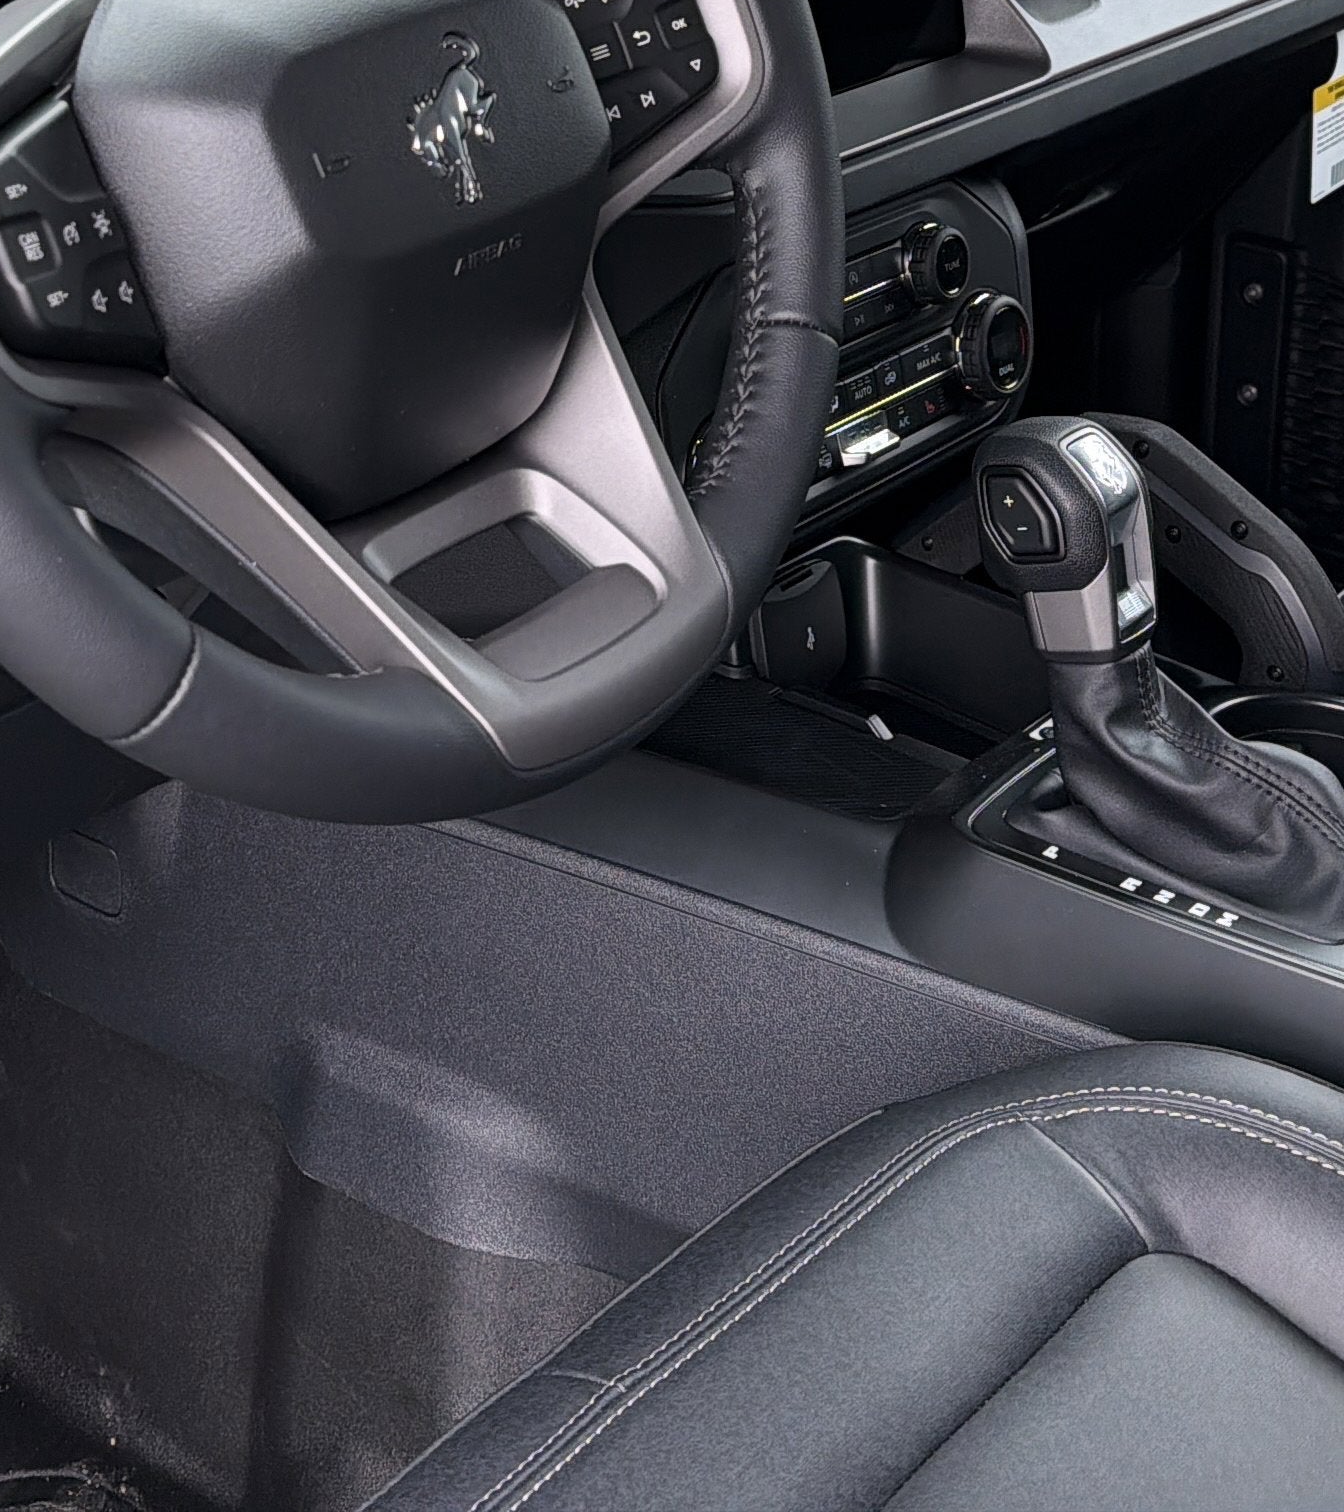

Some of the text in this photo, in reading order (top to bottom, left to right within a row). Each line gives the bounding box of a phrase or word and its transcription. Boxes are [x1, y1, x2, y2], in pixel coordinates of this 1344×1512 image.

[671, 17, 688, 31] OK
[453, 232, 524, 277] AIRBAG
[945, 258, 961, 272] TUNE
[916, 352, 942, 371] MAX A/C
[999, 363, 1015, 377] DUAL
[854, 386, 873, 400] AUTO
[898, 415, 911, 428] A/C
[1042, 845, 1059, 860] P
[1119, 877, 1143, 892] R
[1152, 889, 1176, 904] N
[1188, 902, 1211, 918] D
